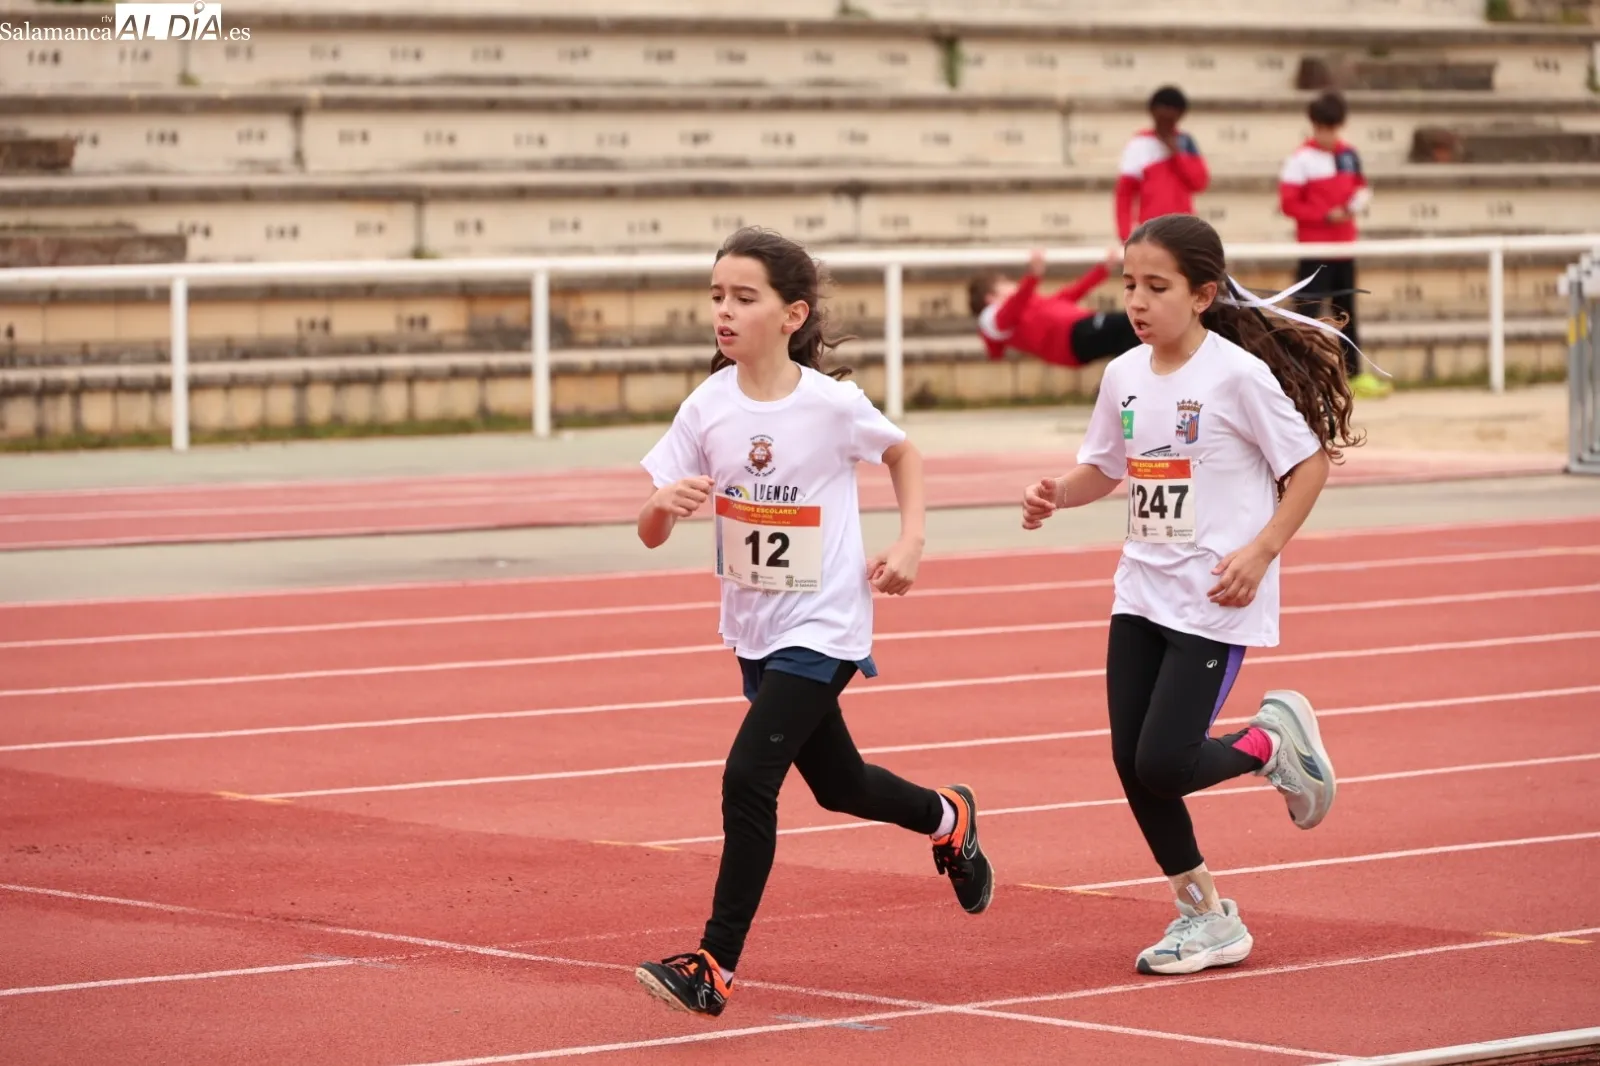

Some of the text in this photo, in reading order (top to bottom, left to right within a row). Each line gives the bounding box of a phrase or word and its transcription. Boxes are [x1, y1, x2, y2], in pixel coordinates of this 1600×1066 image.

[754, 483, 798, 502] LUENGO
[756, 506, 797, 515] ESCOLARES
[745, 530, 790, 568] 12
